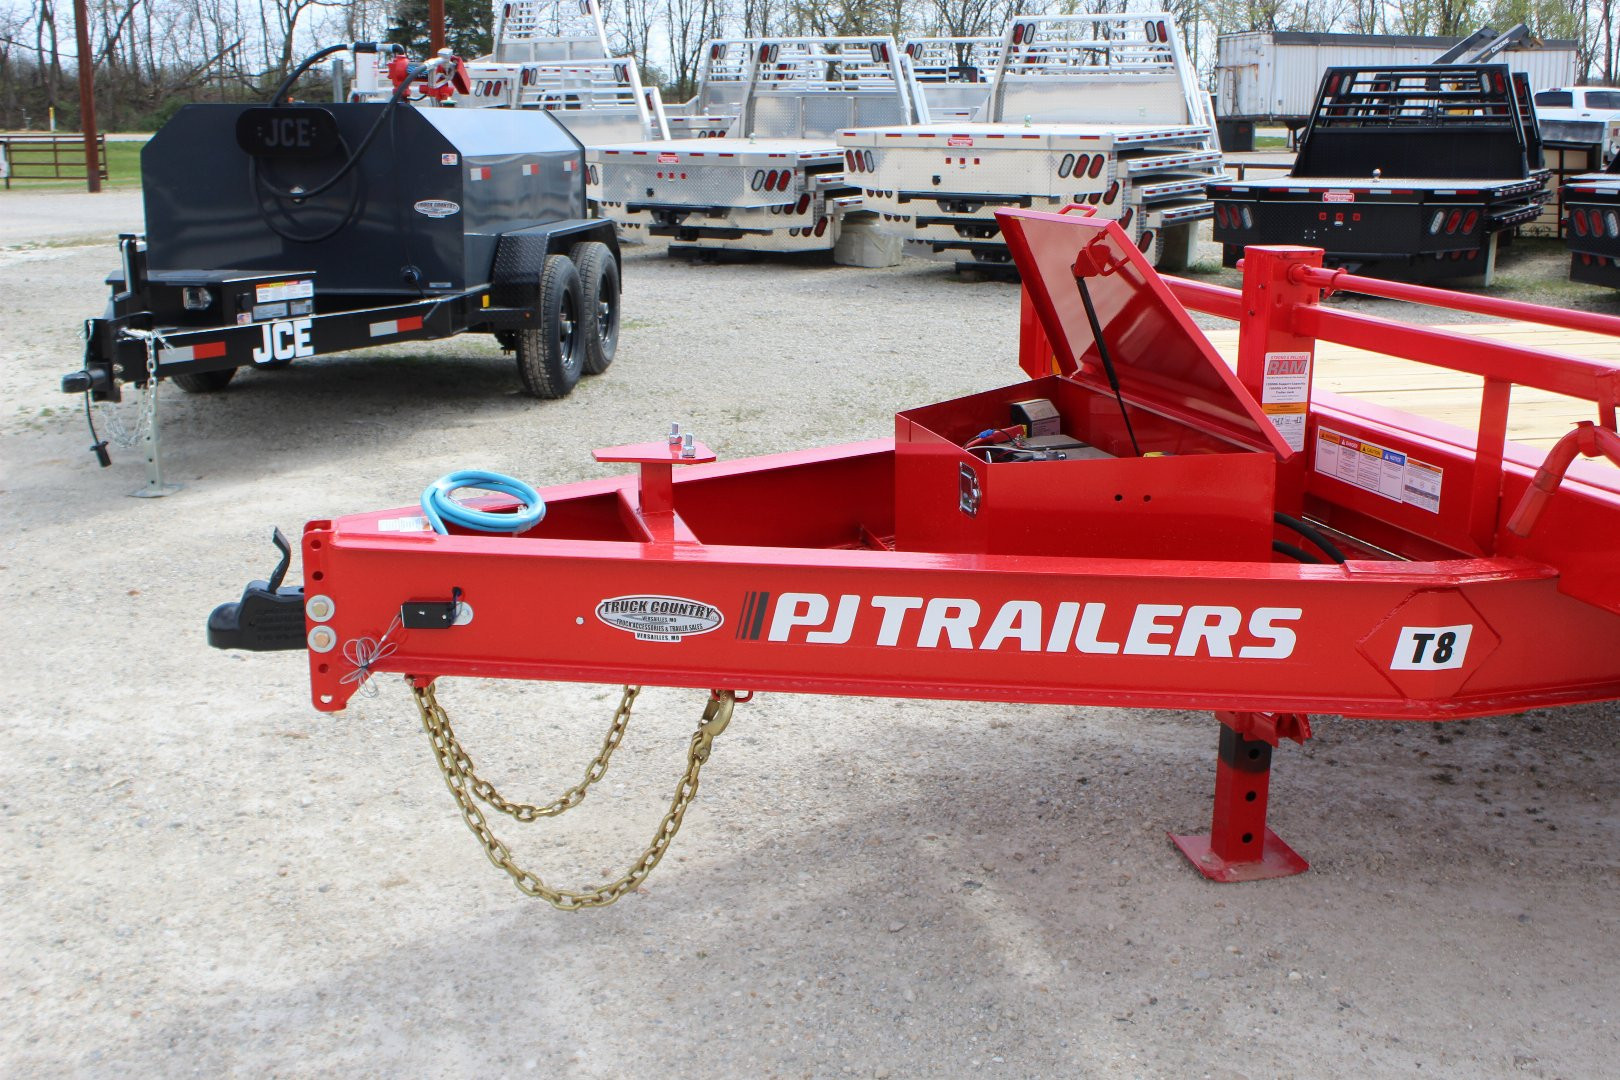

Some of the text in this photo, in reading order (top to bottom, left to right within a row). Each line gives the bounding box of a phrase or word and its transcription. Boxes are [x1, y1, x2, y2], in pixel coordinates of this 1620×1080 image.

[264, 118, 310, 146] JCE
[253, 319, 314, 363] JCE
[1267, 360, 1307, 375] RAM
[603, 600, 715, 618] TRUCK COUNTRY
[632, 622, 665, 632] ACCESSORIES
[689, 623, 703, 631] SALES
[767, 592, 1303, 660] PJ TRAILERS
[1411, 631, 1456, 664] T8
